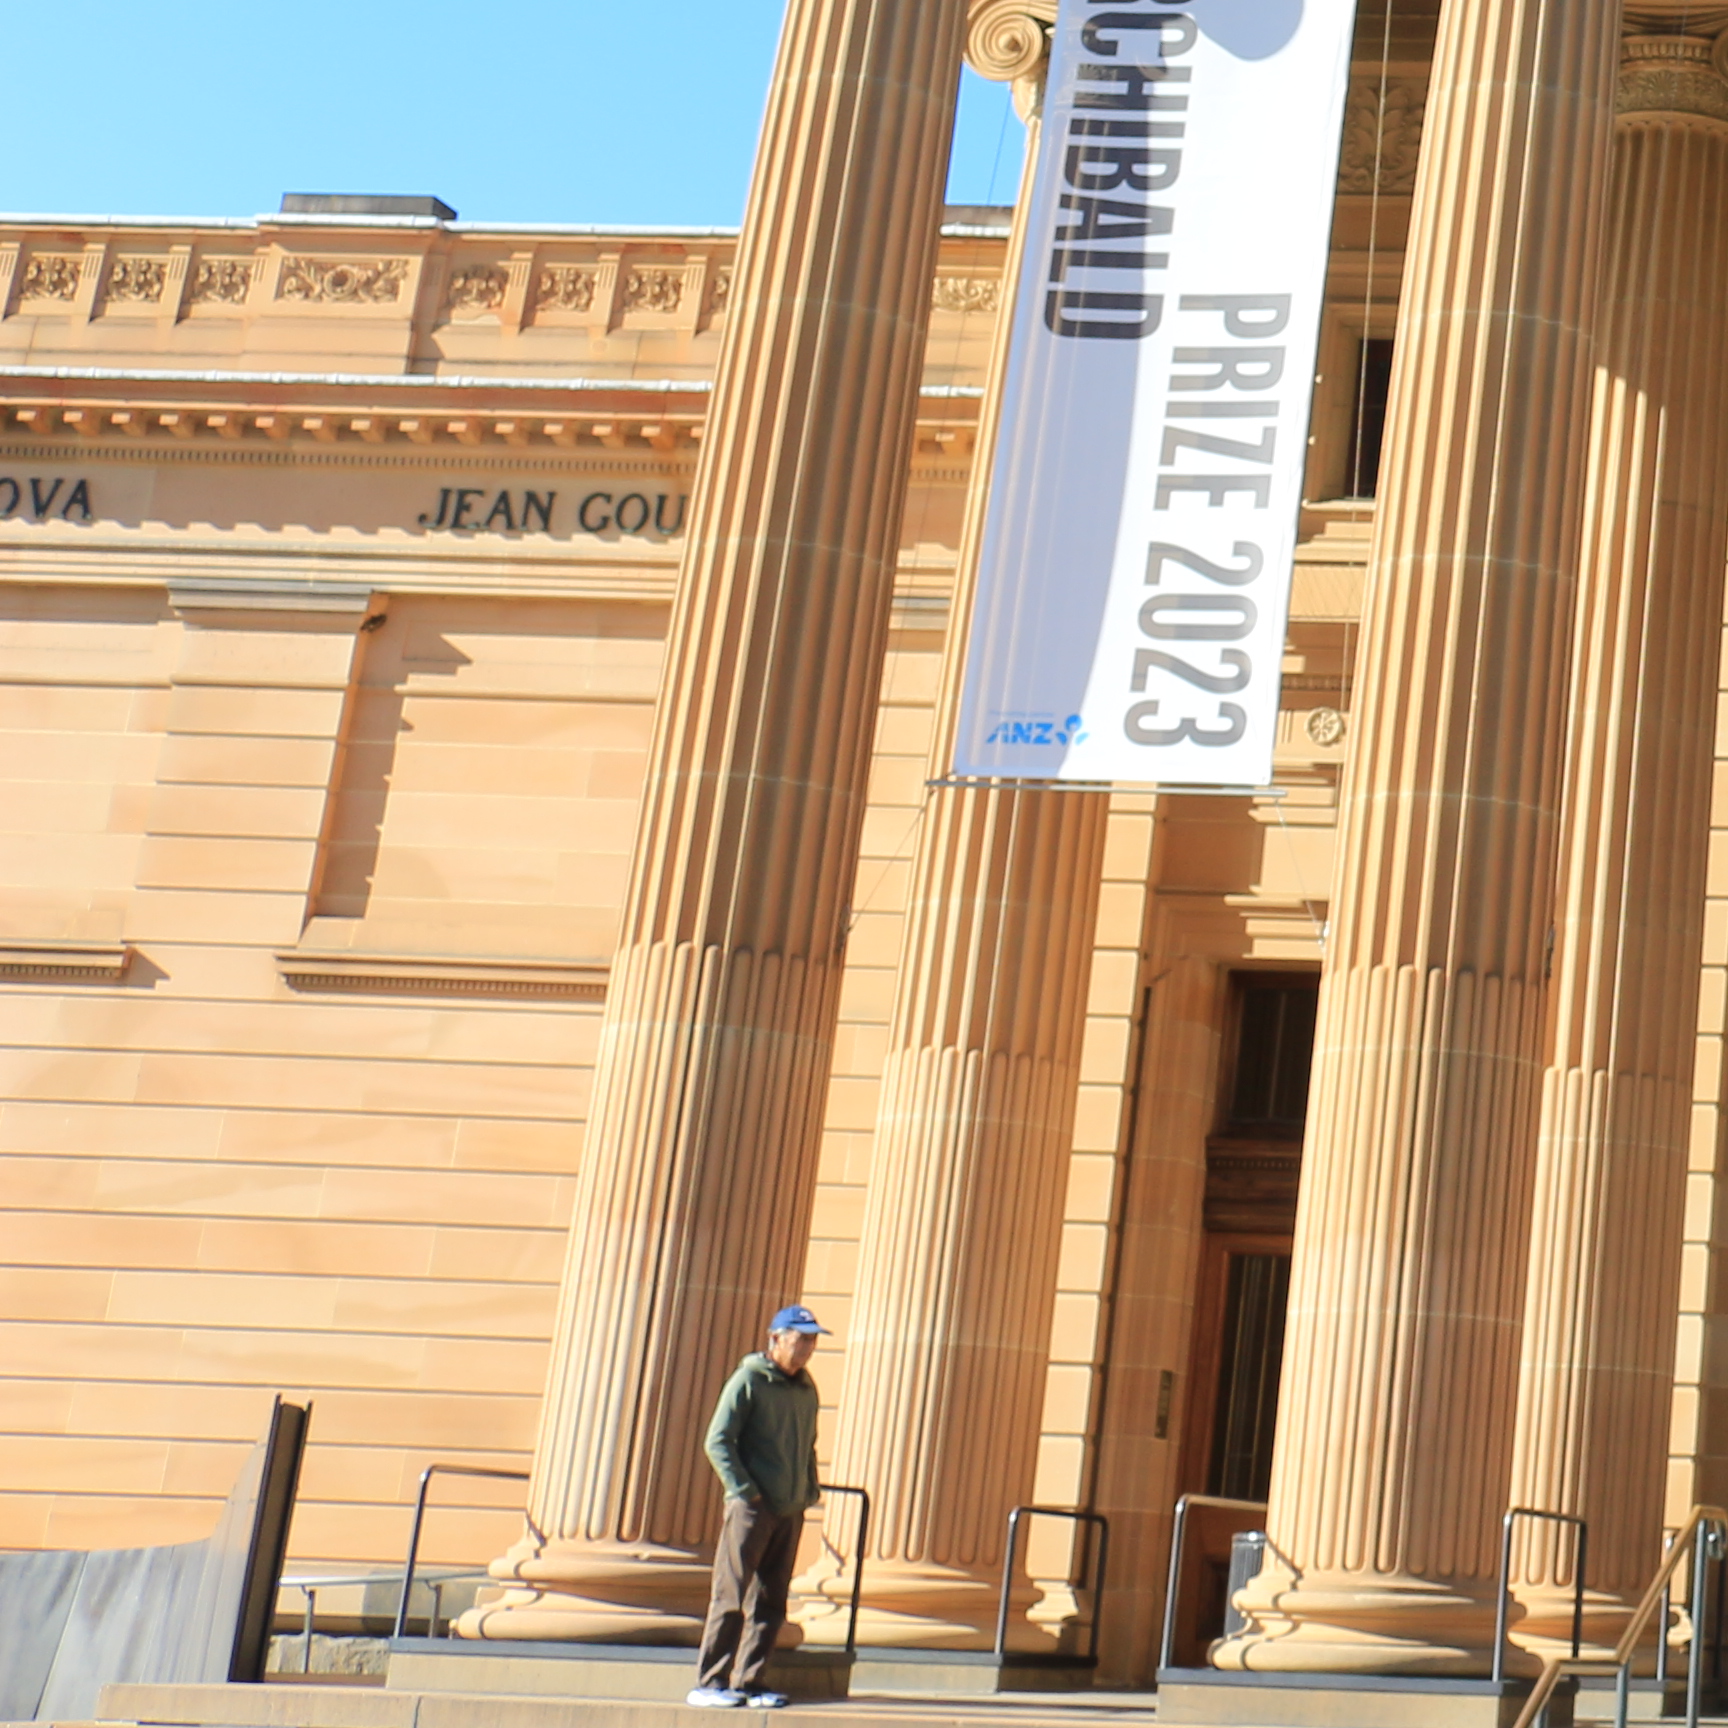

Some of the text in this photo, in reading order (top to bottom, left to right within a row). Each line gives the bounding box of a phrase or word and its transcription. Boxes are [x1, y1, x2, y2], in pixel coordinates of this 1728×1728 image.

[417, 488, 688, 535] JEAN GOU
[1123, 293, 1292, 749] PRIZE 2023
[986, 722, 1055, 745] ANZ
